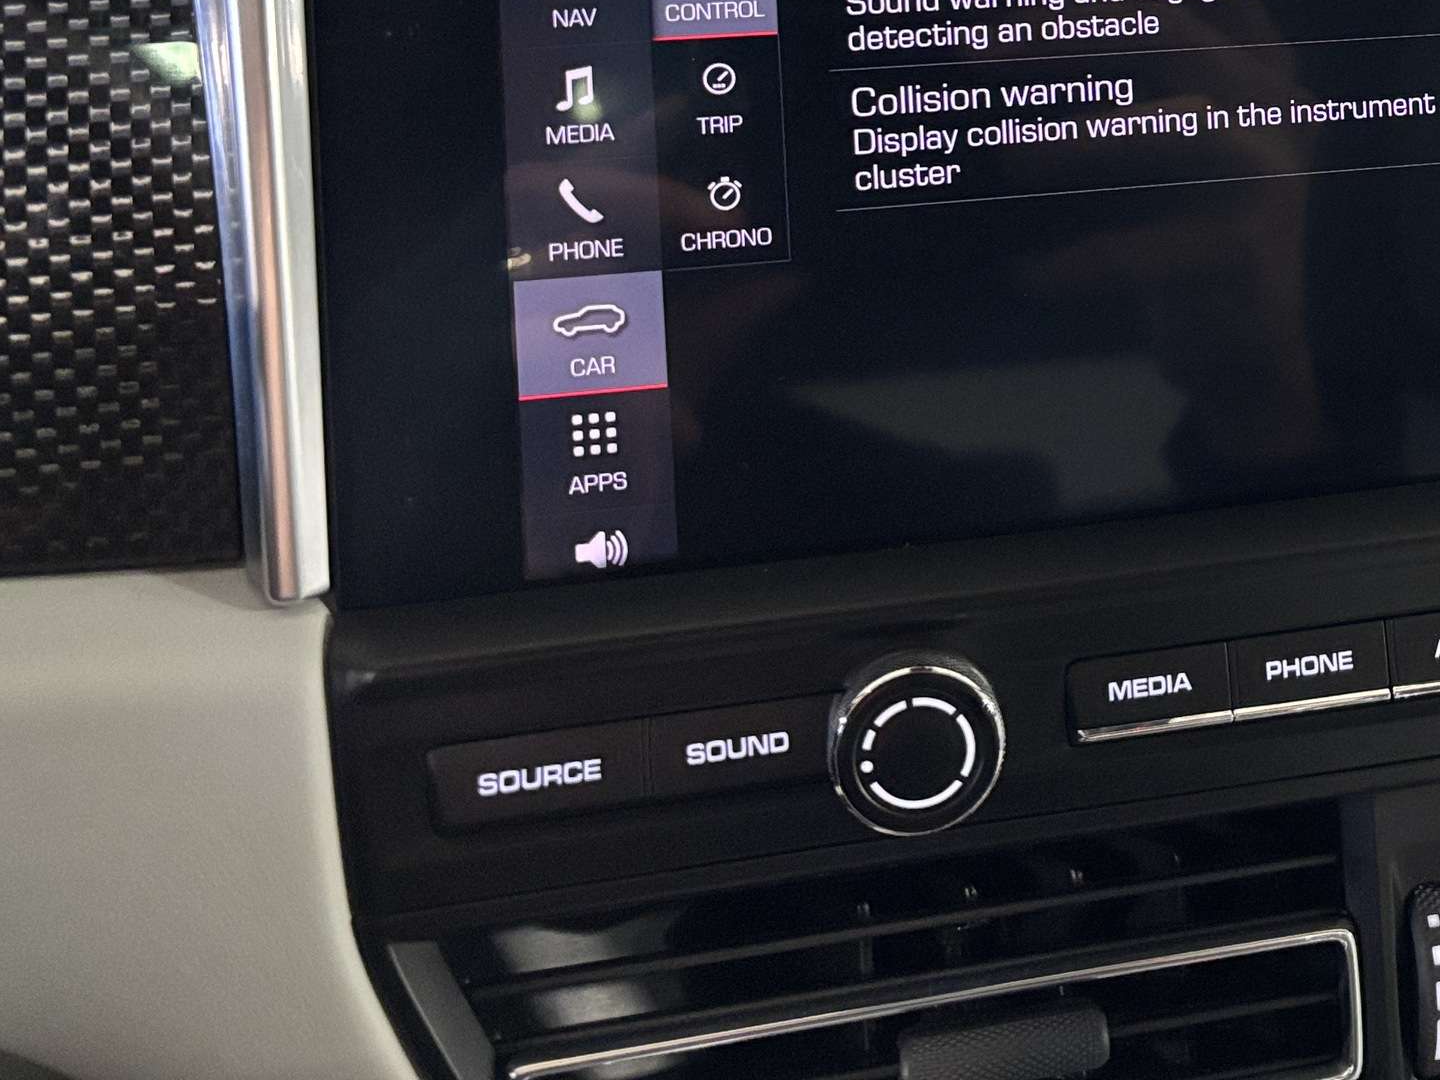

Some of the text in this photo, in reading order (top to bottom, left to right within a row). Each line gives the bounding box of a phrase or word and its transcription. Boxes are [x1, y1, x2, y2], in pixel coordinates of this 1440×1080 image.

[552, 7, 597, 29] NAV
[664, 0, 766, 22] CONTROL
[847, 10, 1160, 52] detecting an obstacle
[851, 73, 1134, 117] Collision warning
[545, 122, 616, 145] MEDIA
[696, 114, 743, 135] TRIP
[853, 92, 1436, 158] Display collision warning in the instrument
[855, 163, 961, 191] cluster
[548, 238, 625, 262] PHONE
[680, 227, 773, 252] CHRONO
[569, 355, 616, 378] CAR
[568, 471, 628, 495] APPS
[1265, 650, 1354, 681] PHONE
[1108, 672, 1193, 702] MEDIA
[685, 731, 790, 766] SOUND
[477, 758, 602, 797] SOURCE
